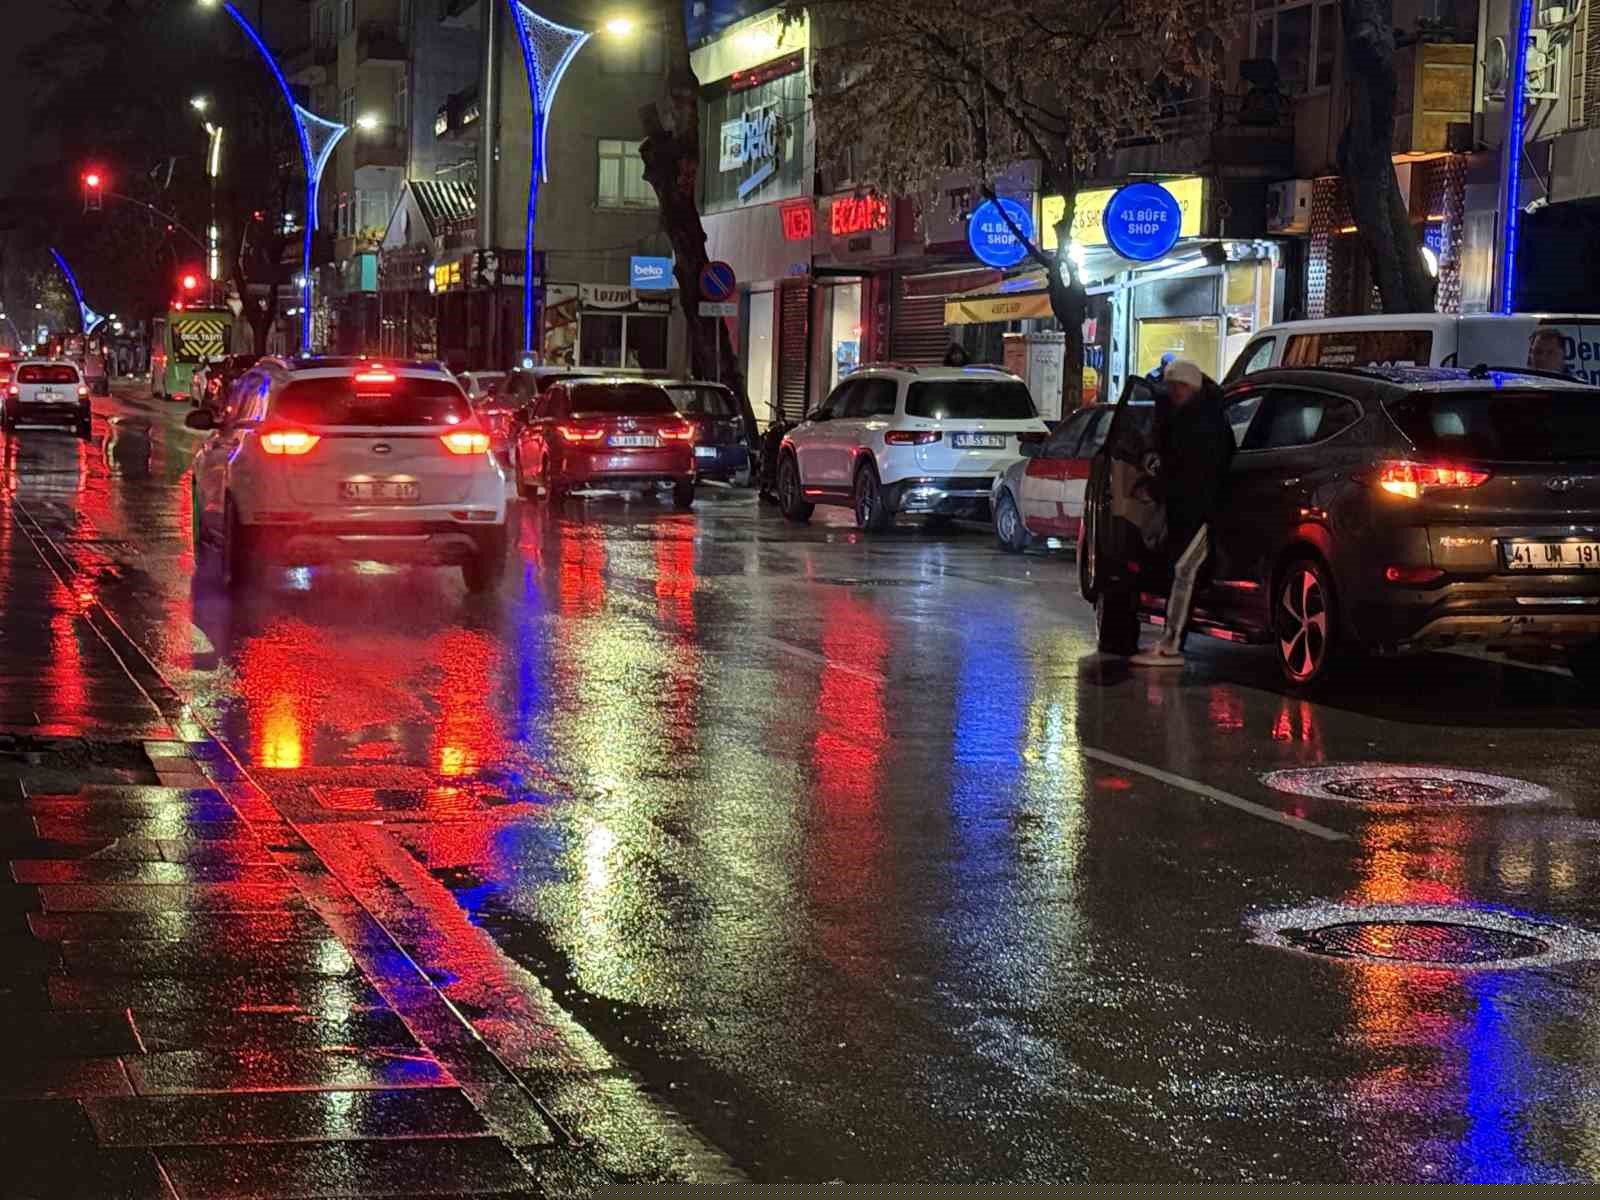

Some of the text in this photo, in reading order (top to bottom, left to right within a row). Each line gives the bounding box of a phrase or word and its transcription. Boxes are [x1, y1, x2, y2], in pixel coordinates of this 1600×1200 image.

[741, 109, 777, 161] beko
[1121, 208, 1168, 222] 41 BÜFE
[981, 223, 994, 233] 41
[1128, 223, 1159, 235] SHOP
[987, 234, 1016, 245] SHOP
[634, 264, 664, 275] beko
[1512, 546, 1532, 563] 41
[1575, 545, 1600, 562] 191
